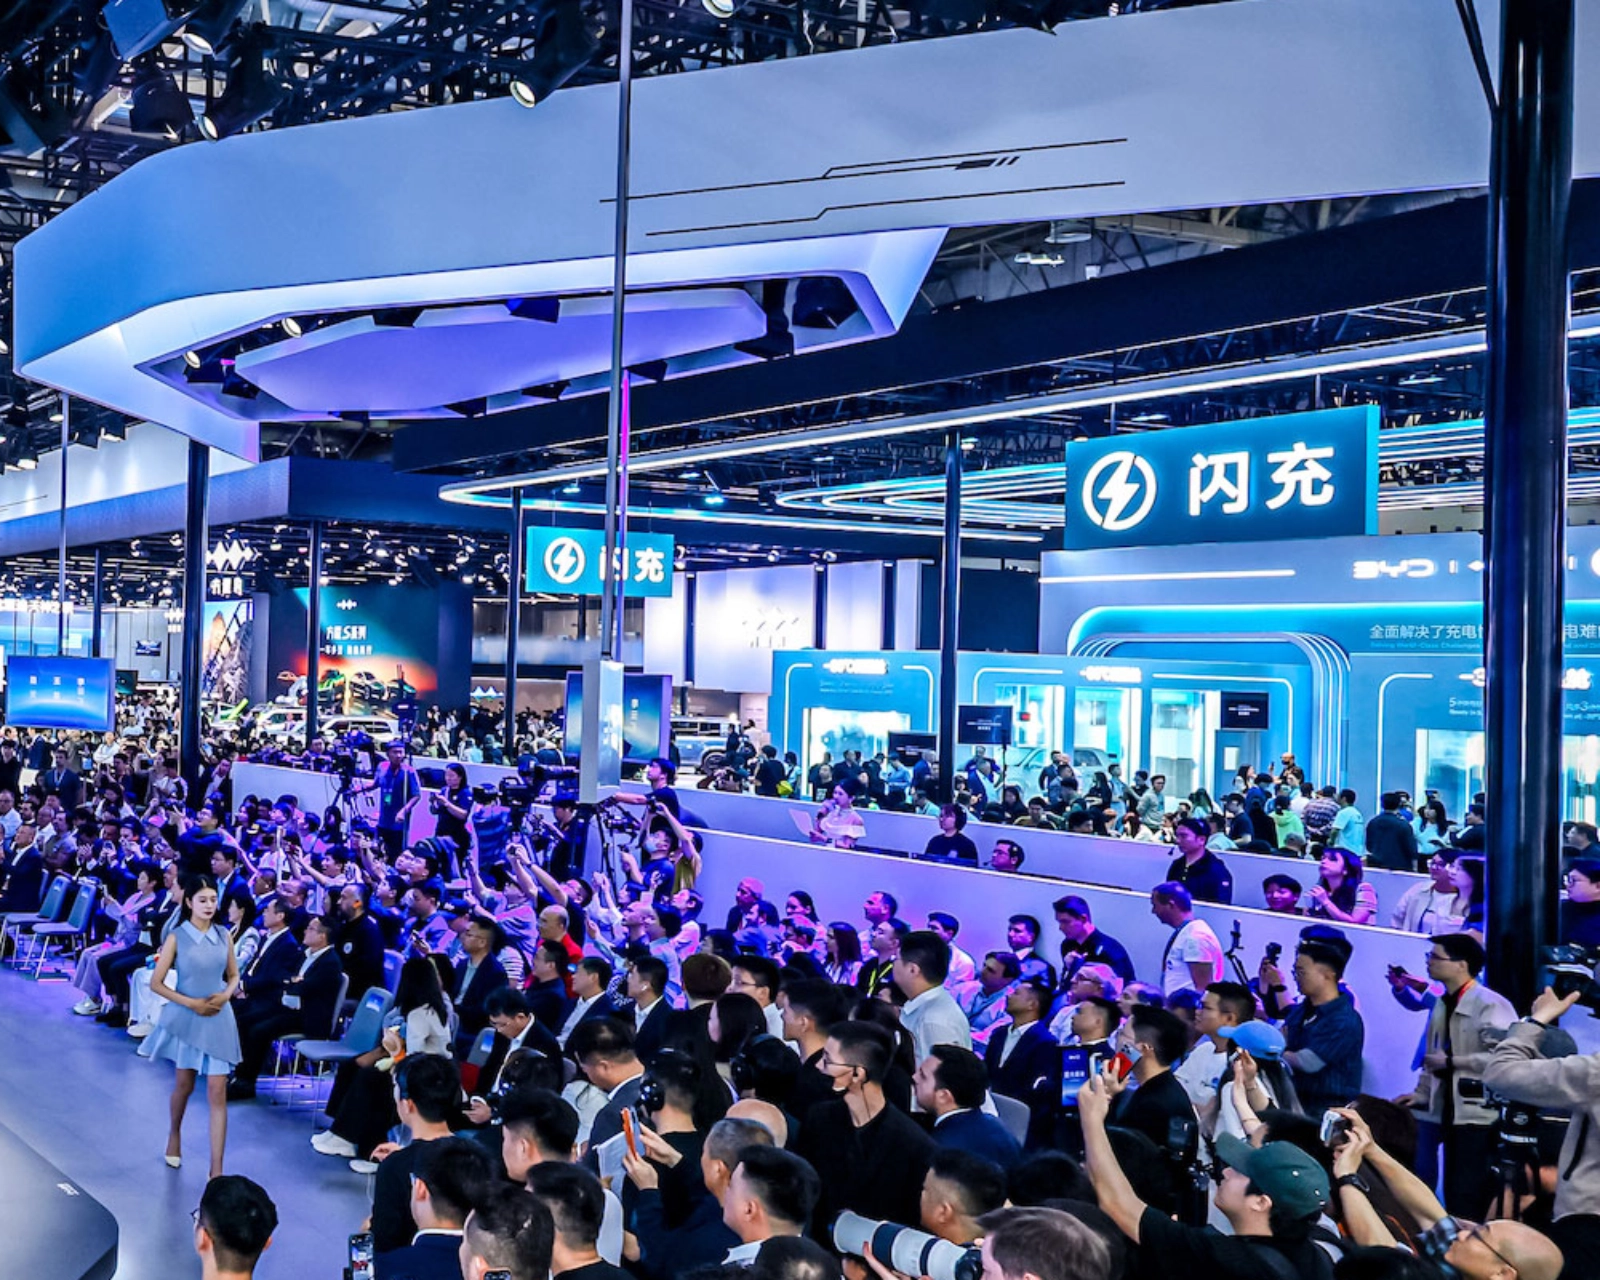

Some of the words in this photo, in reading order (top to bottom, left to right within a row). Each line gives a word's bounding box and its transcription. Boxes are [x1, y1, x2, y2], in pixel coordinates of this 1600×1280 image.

[1188, 441, 1335, 517] 闪充
[1352, 558, 1436, 579] BYD
[1369, 623, 1484, 640] 全面解决了充电
[1564, 624, 1600, 641] 电难
